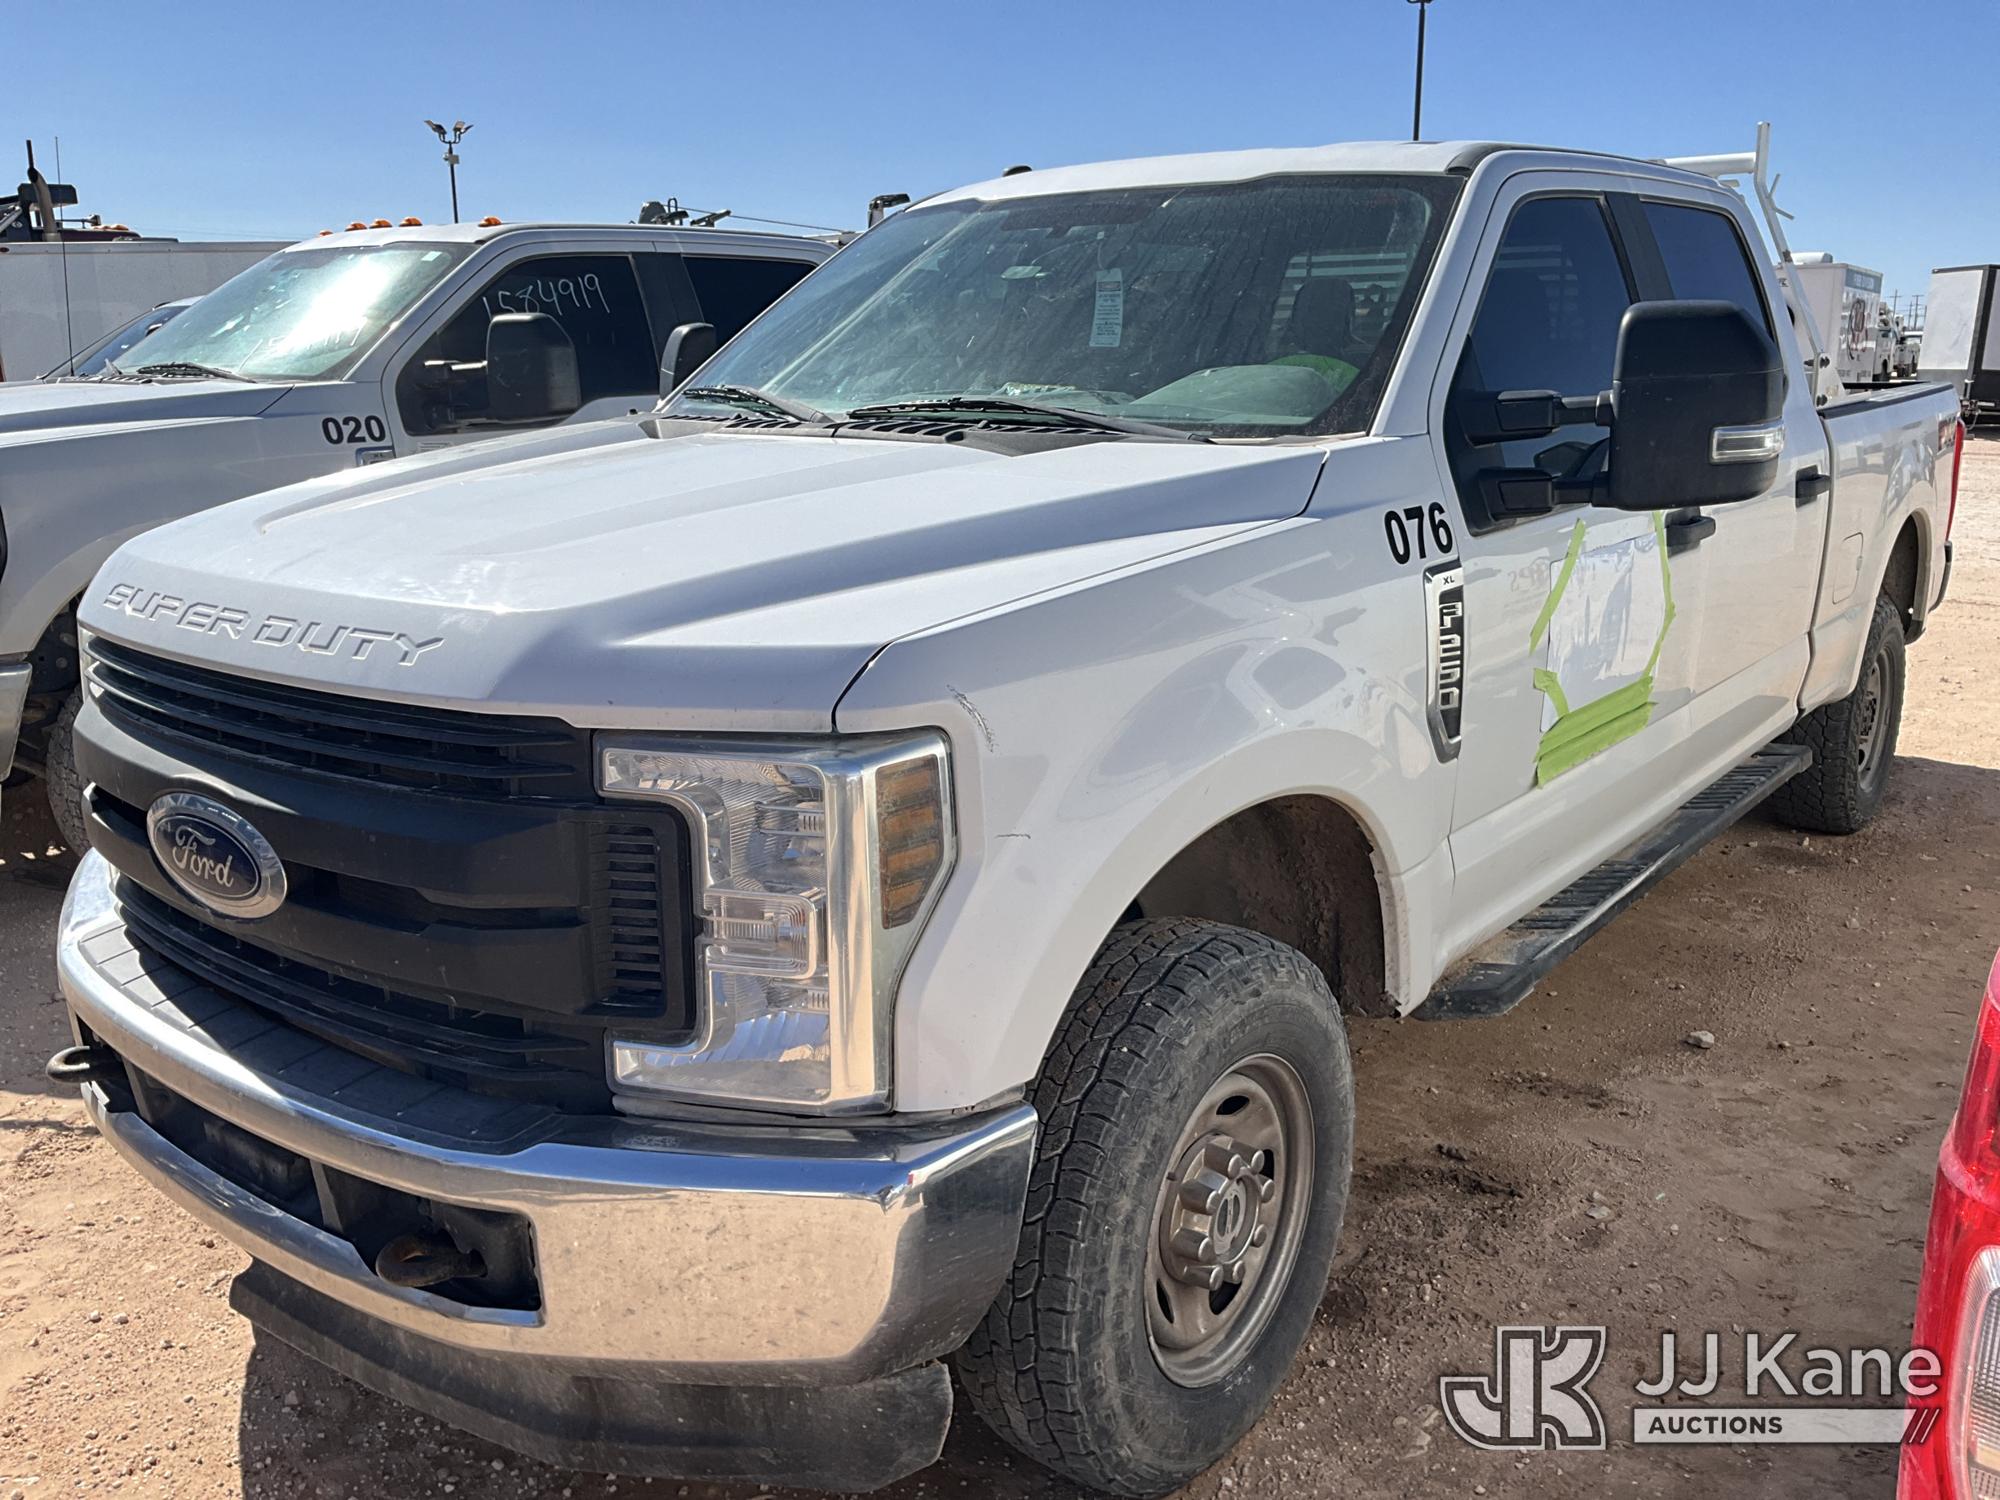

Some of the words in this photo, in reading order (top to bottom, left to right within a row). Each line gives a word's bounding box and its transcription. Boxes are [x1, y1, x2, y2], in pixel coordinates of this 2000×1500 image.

[321, 415, 386, 445] 020
[1384, 501, 1454, 565] 076
[1443, 575, 1455, 585] XL
[103, 583, 251, 640] SUPER
[251, 614, 446, 667] DUTY
[172, 825, 234, 888] Ford
